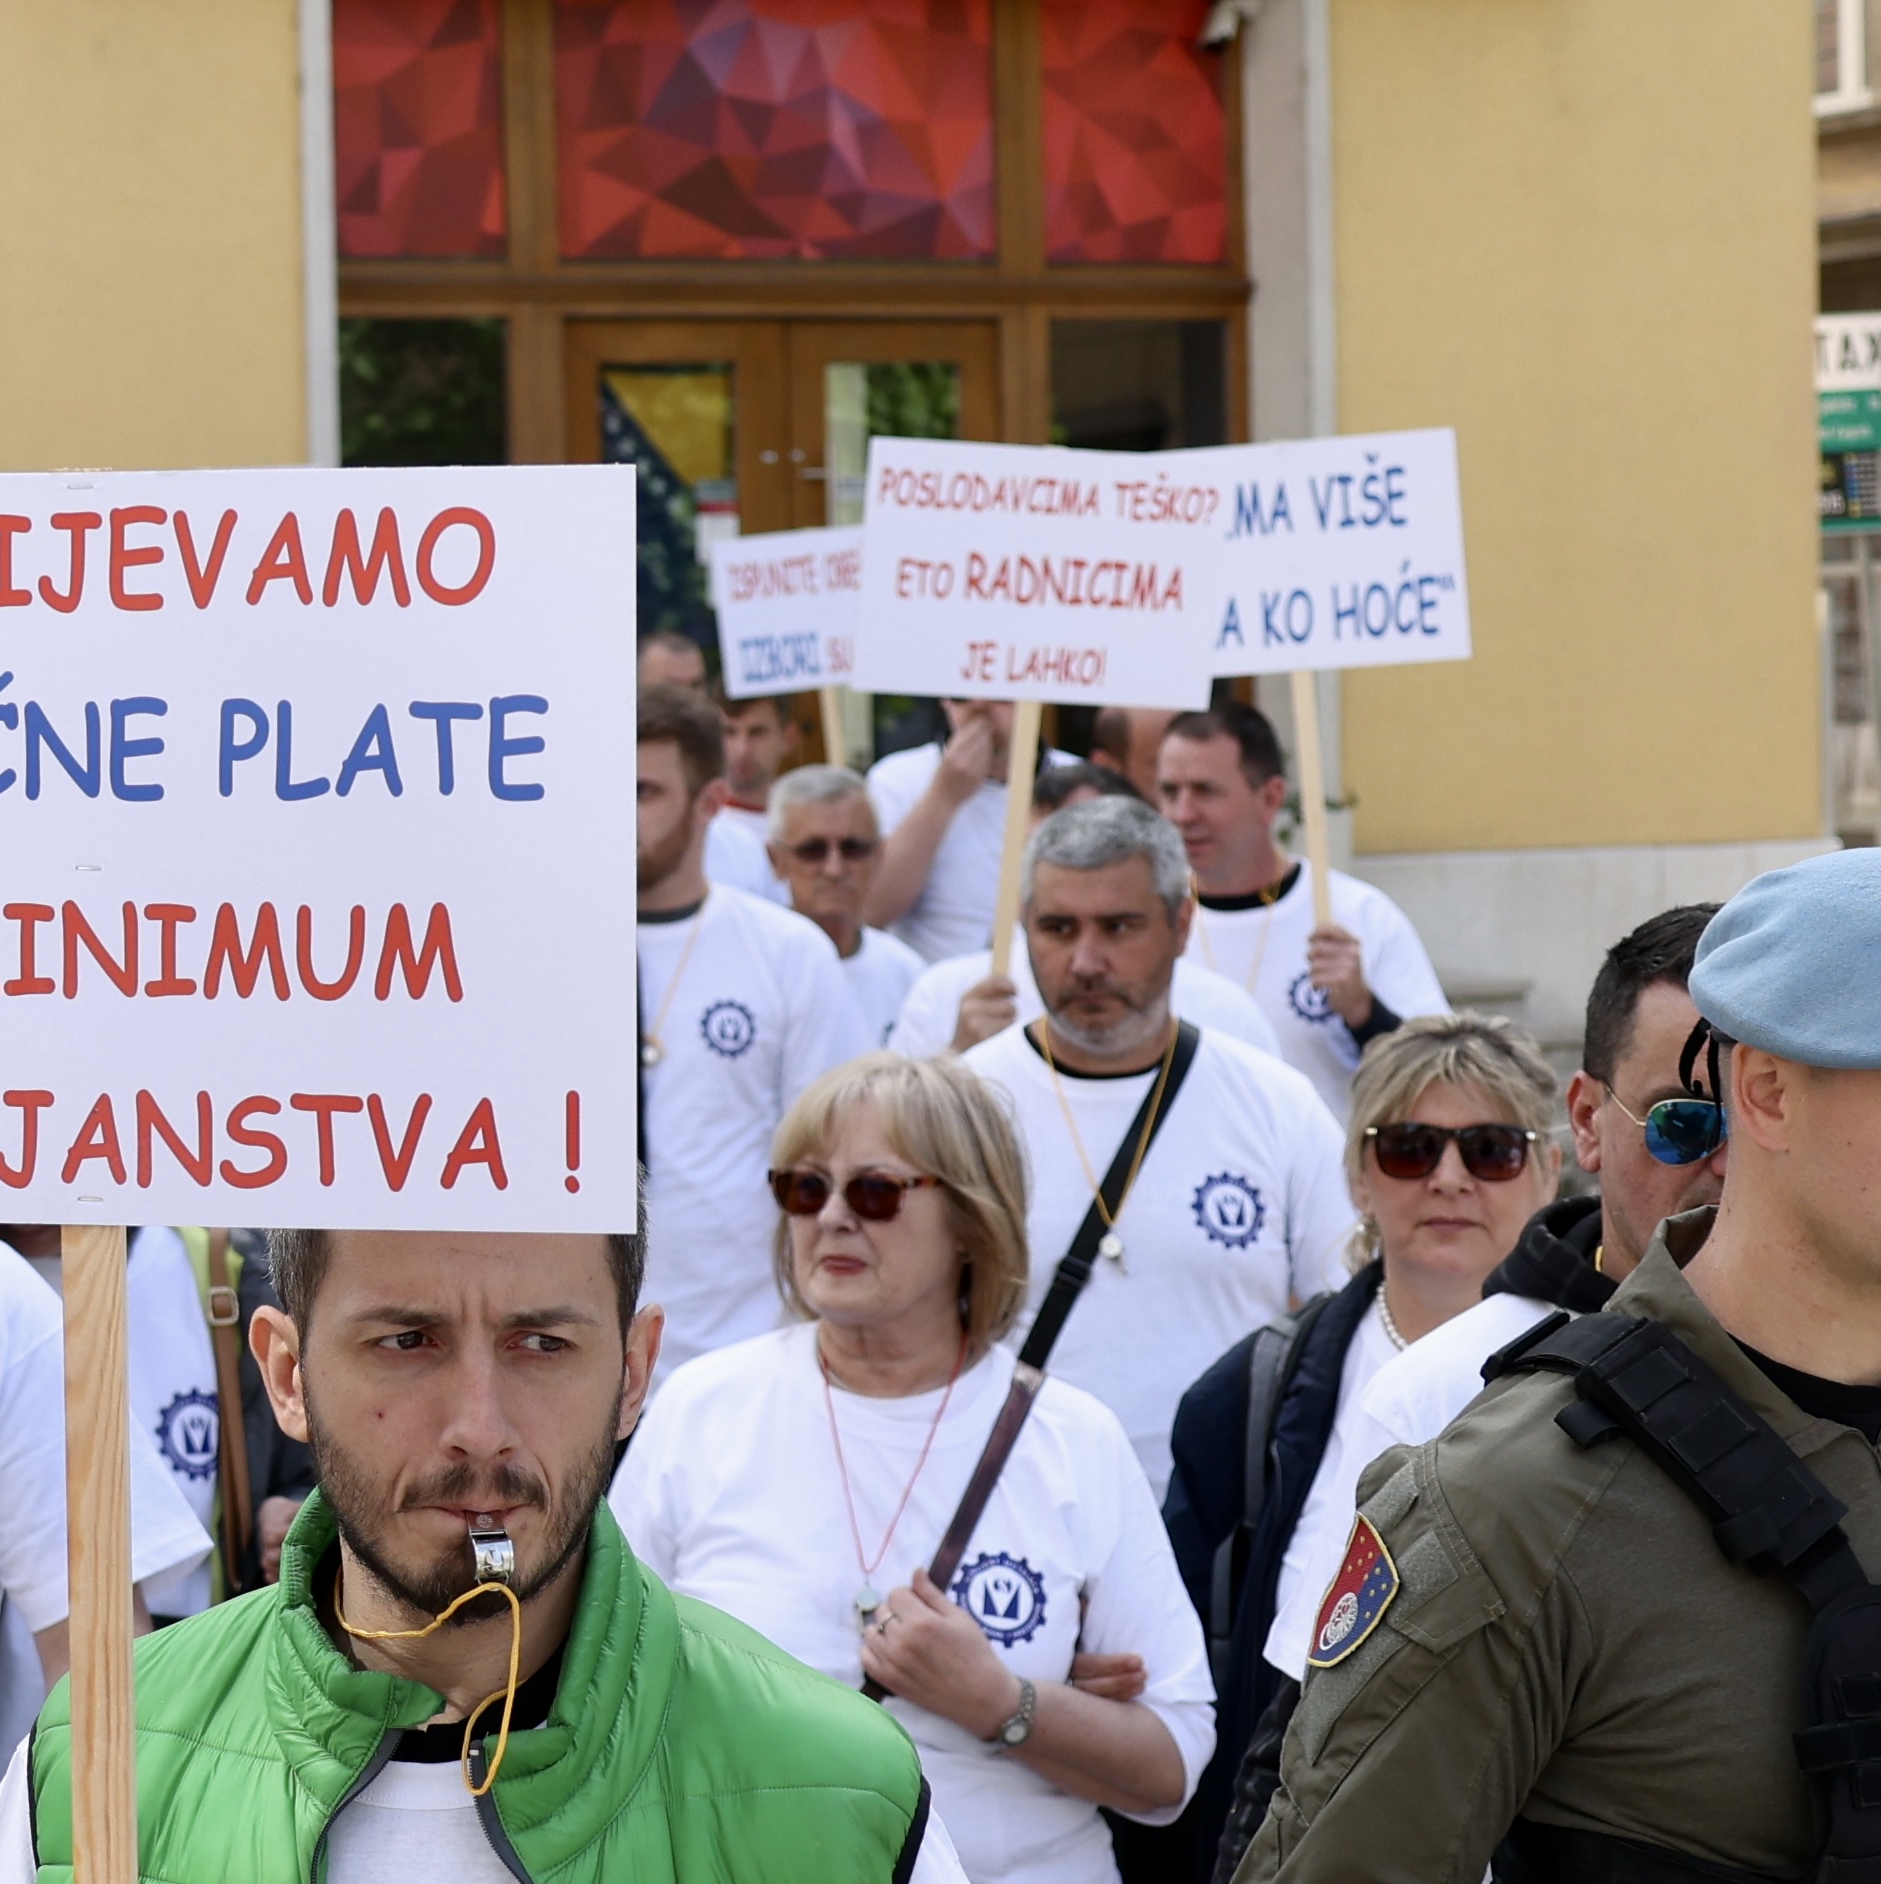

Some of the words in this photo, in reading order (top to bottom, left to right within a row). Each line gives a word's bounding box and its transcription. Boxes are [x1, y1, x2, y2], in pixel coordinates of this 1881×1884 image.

[880, 466, 1100, 516] POSLODAVCIMA
[1114, 463, 1220, 524] TEŠKO?
[1308, 452, 1408, 530] VIŠE
[896, 556, 956, 600] ETO
[965, 551, 1184, 610] RADNICIMA
[1260, 586, 1316, 648] KO
[962, 640, 998, 673] JE
[1006, 647, 1106, 686] LAHKO!
[218, 693, 550, 804] PLATE
[565, 1090, 581, 1194] !
